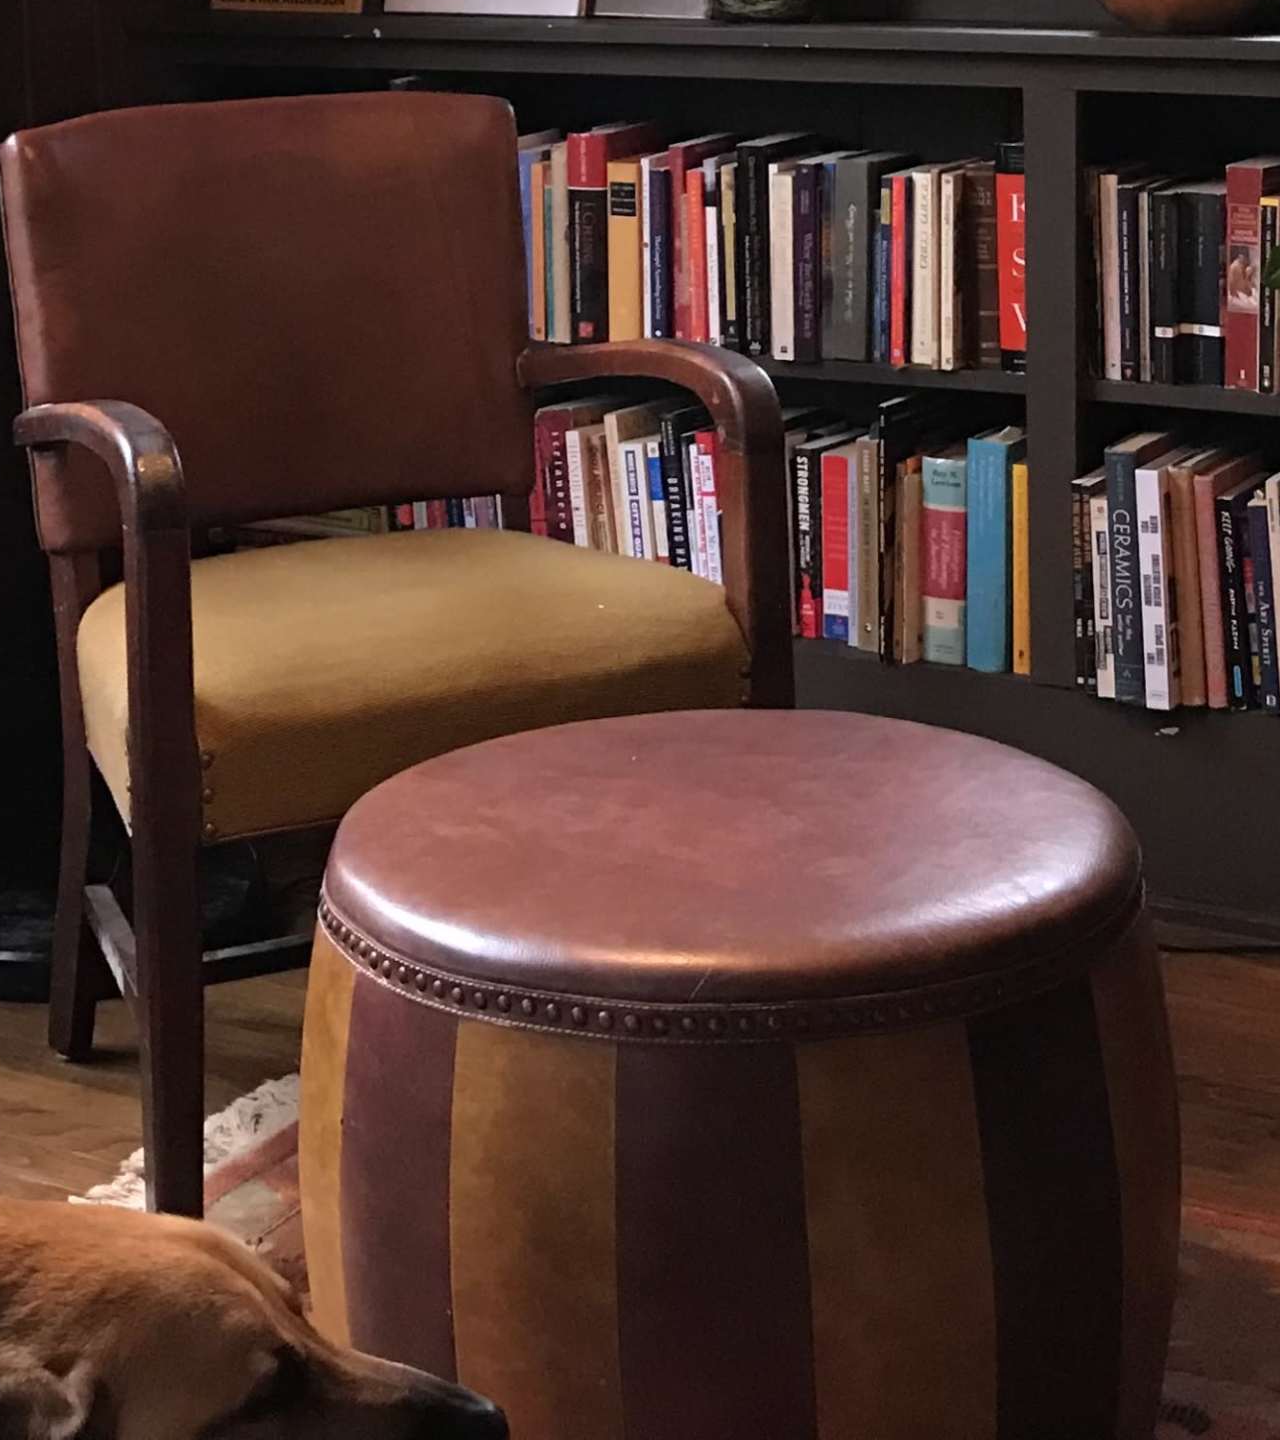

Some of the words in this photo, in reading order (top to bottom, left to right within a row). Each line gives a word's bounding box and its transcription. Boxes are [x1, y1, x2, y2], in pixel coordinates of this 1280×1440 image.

[795, 455, 811, 531] STRONGMEN
[629, 501, 641, 526] CITY
[665, 477, 685, 543] BREAKING
[675, 548, 688, 570] HA
[1220, 511, 1231, 532] KEEP
[631, 537, 644, 558] QUA
[1112, 508, 1133, 609] CERAMICS
[1224, 537, 1235, 573] GOING
[1125, 613, 1133, 627] for
[1258, 600, 1269, 624] ART
[1125, 629, 1133, 641] the
[1261, 627, 1272, 665] SPIRIT
